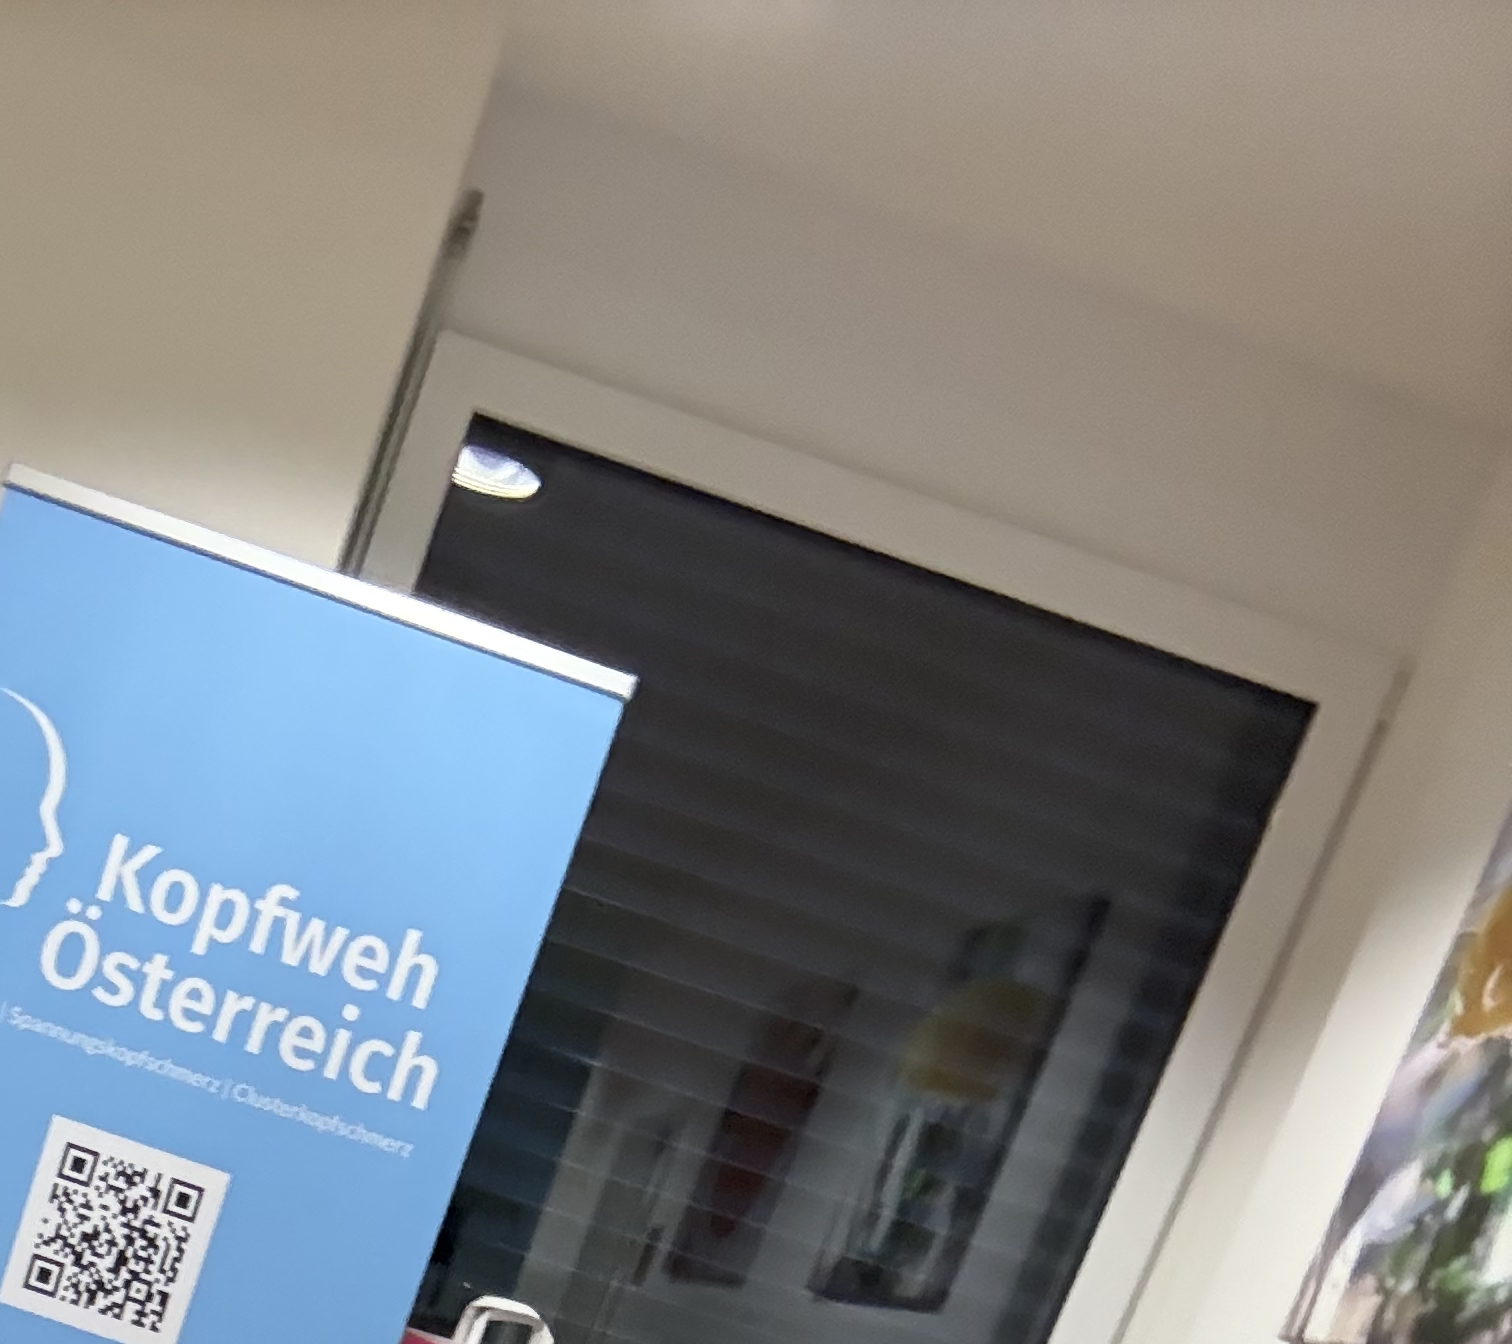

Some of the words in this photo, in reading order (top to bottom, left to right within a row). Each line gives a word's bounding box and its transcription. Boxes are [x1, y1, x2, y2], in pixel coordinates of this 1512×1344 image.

[39, 897, 439, 1110] Österreich
[95, 833, 439, 1010] Kopfweh
[6, 1005, 221, 1093] Spannungskopfschmerz
[231, 1082, 415, 1159] Clusterkopfschmerz
